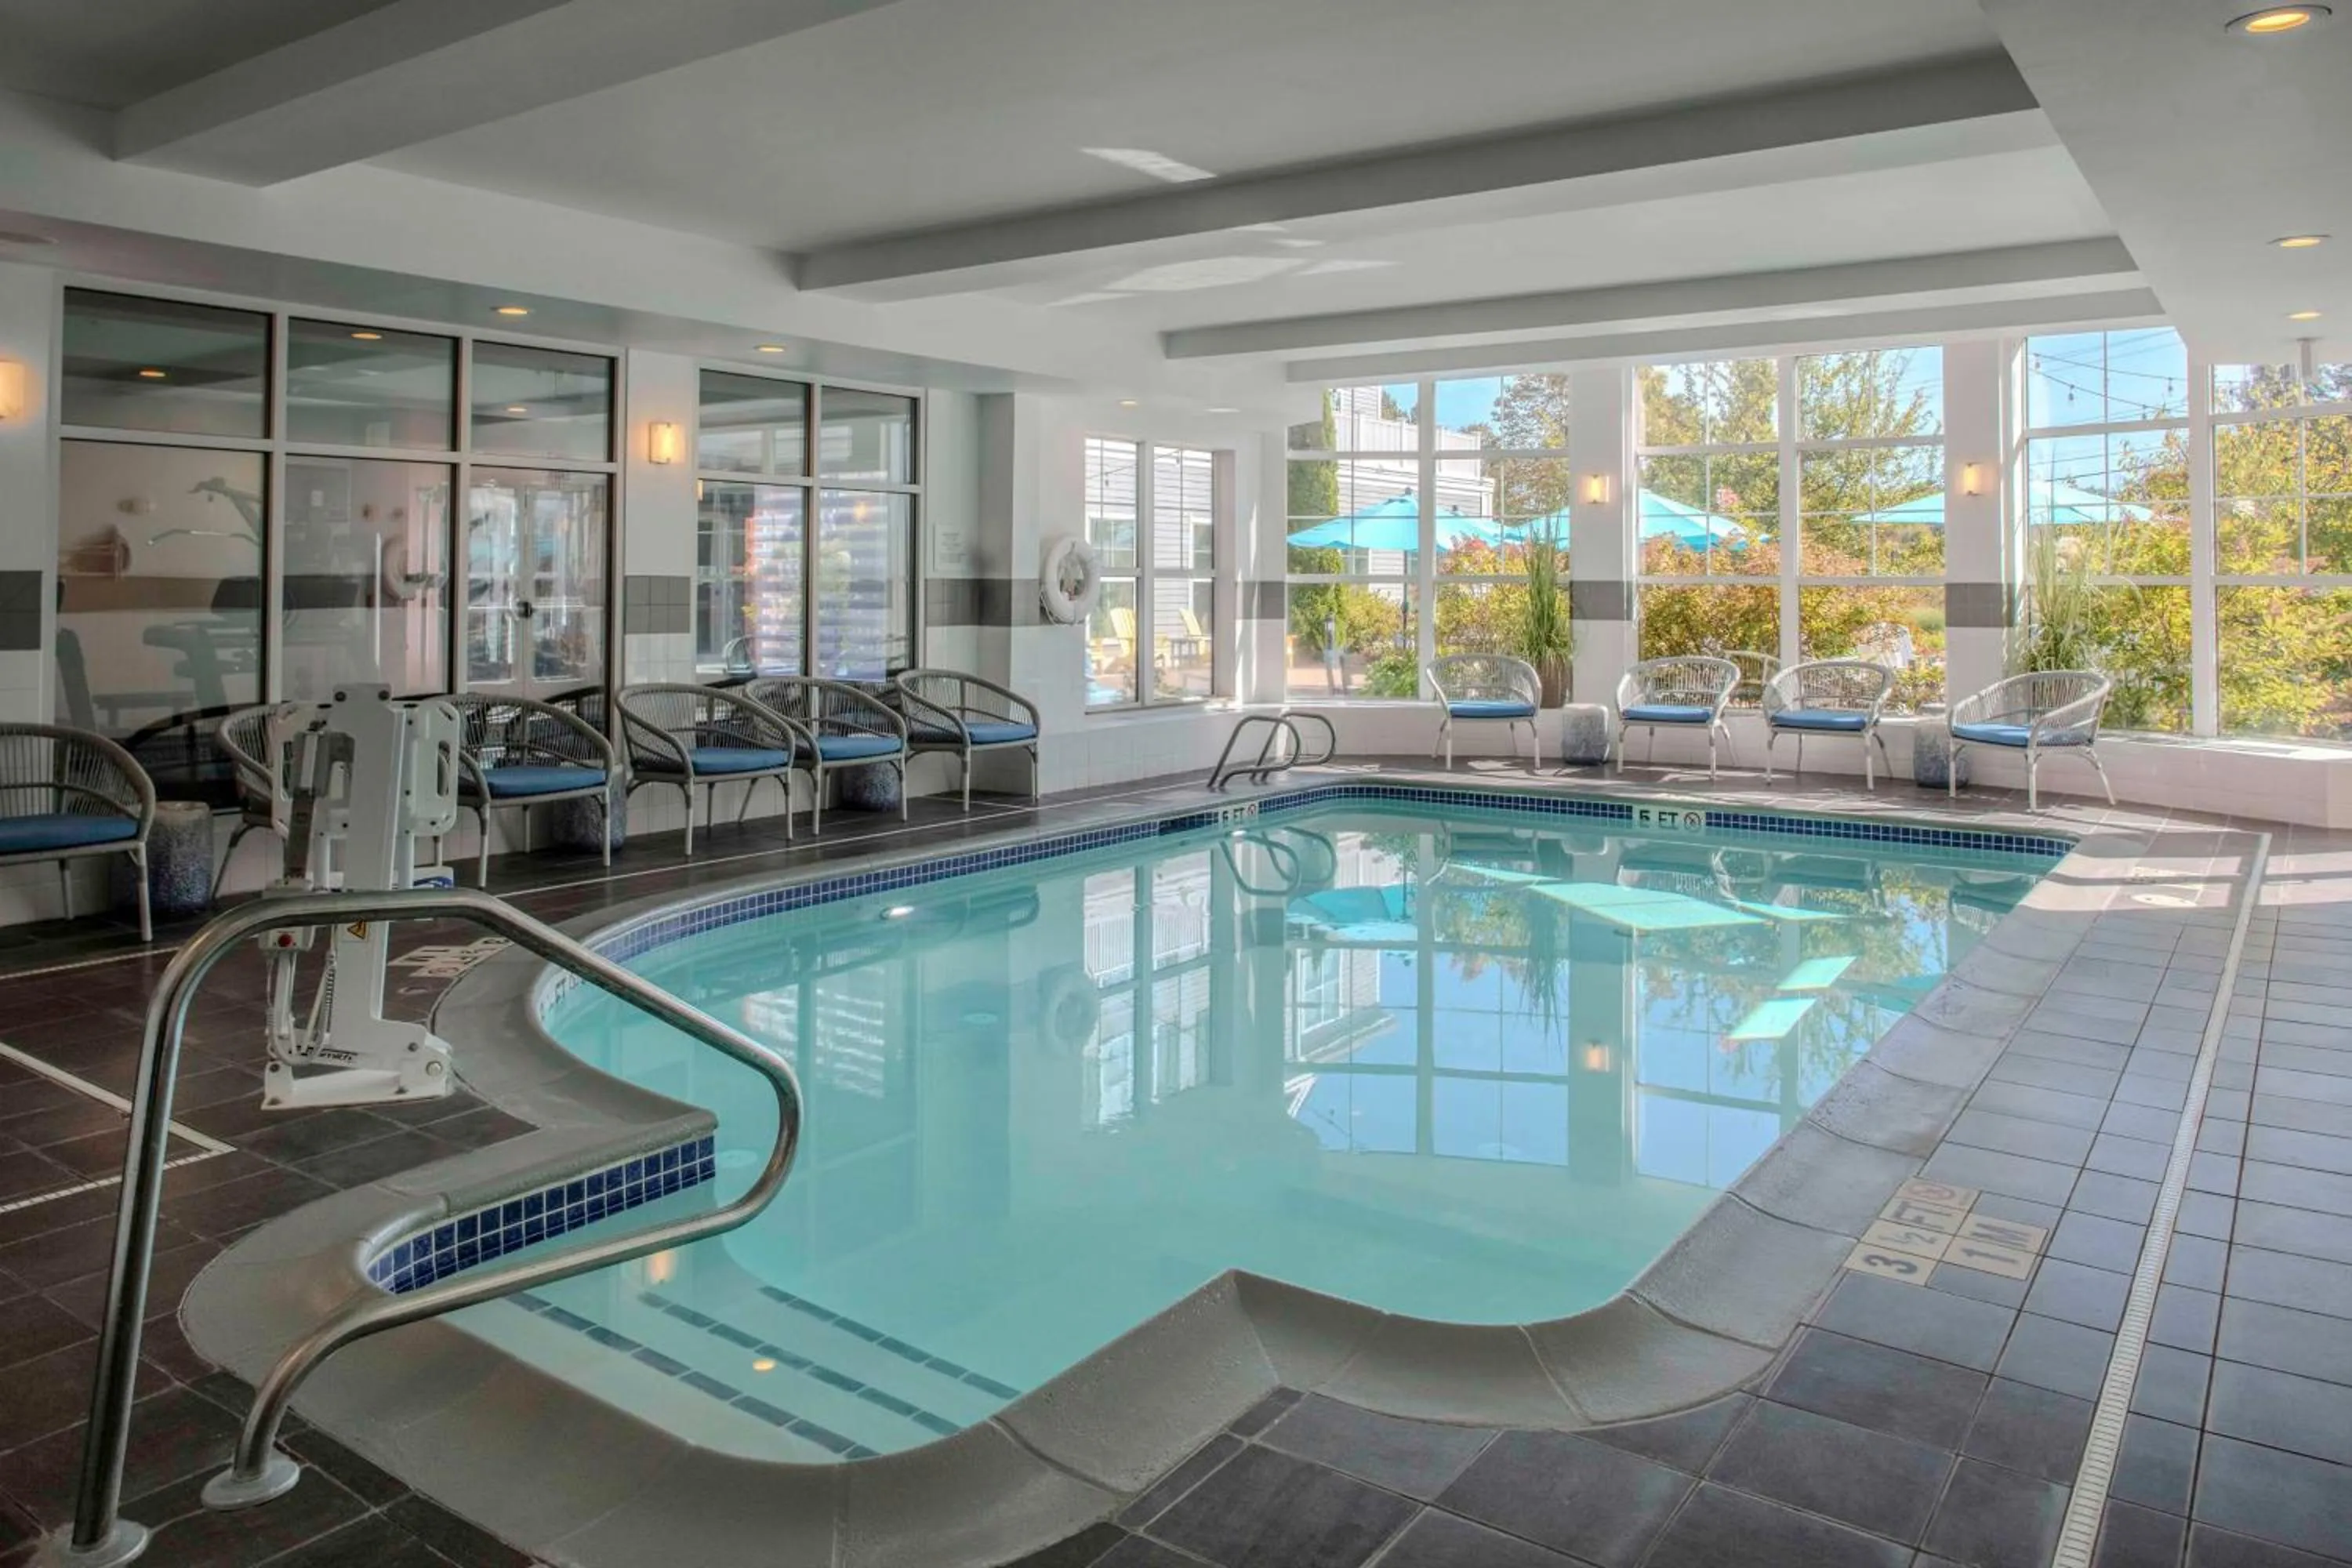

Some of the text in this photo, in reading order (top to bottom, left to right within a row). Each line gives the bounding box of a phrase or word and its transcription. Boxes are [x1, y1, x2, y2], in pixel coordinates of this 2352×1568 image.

[1658, 811, 1679, 823] FT
[1862, 1254, 1918, 1276] 3
[1890, 1200, 1954, 1230] FT
